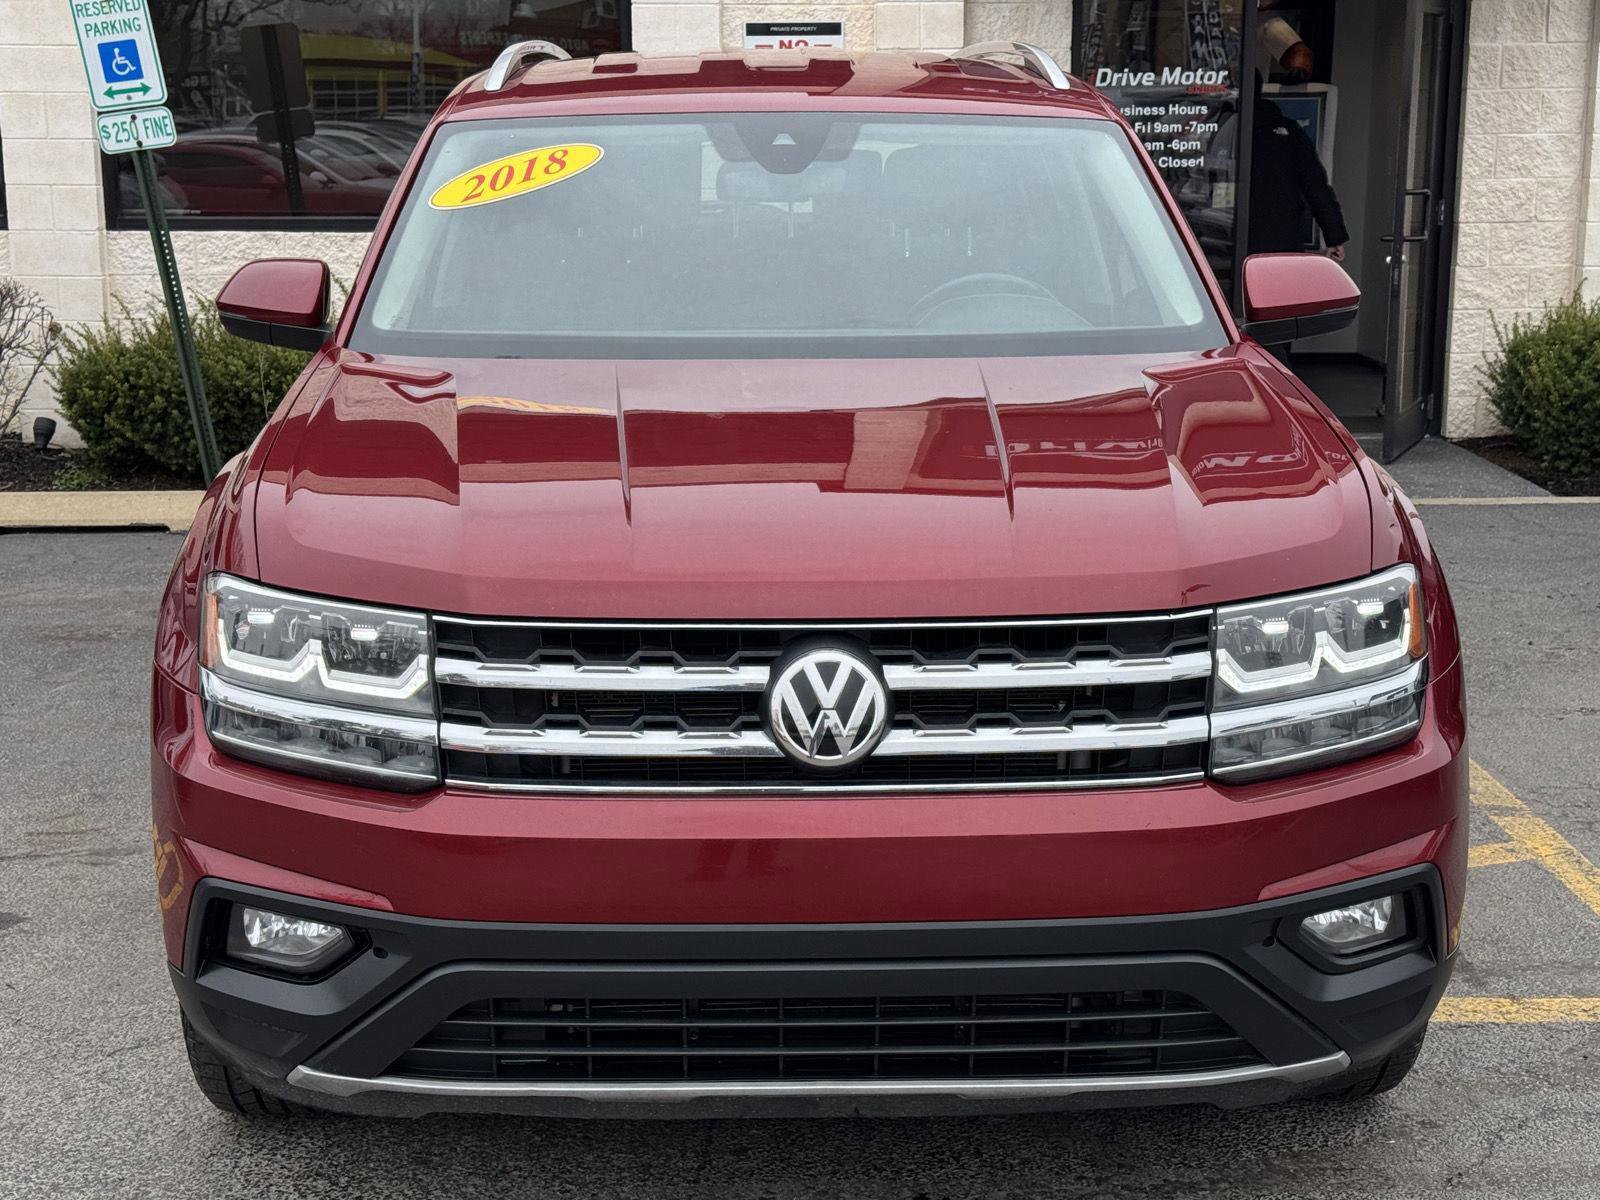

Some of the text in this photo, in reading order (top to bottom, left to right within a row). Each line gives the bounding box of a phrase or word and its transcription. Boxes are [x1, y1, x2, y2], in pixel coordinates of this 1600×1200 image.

[75, 0, 141, 18] RESERVED
[84, 17, 142, 38] PARKING
[1160, 67, 1228, 85] Motor
[1120, 104, 1208, 116] siness Hours
[142, 115, 172, 139] FINE
[1153, 121, 1182, 133] 9am
[1158, 156, 1204, 168] Closed
[461, 149, 569, 203] 2018
